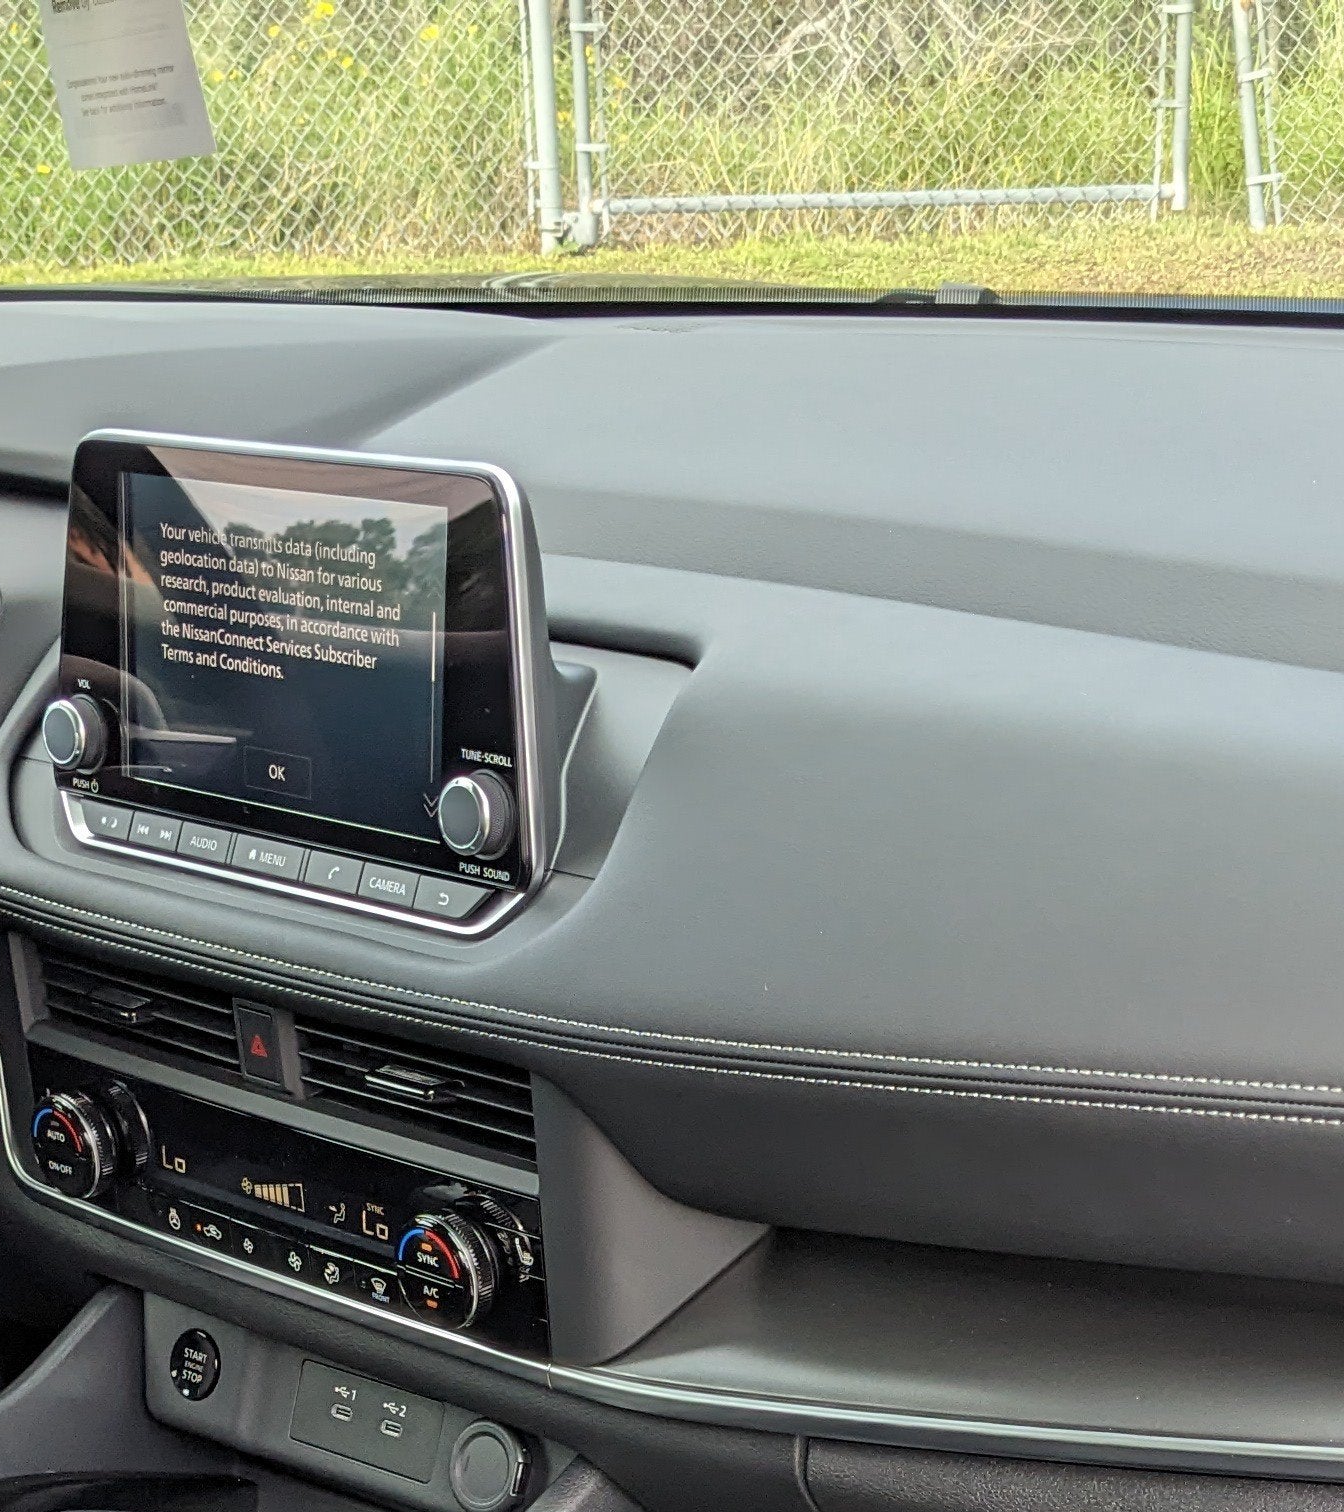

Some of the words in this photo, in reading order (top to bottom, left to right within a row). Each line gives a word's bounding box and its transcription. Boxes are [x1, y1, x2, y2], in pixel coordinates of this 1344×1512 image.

[160, 523, 186, 540] Your
[188, 527, 227, 545] vehicle
[230, 533, 282, 553] transmits
[286, 538, 311, 556] data
[315, 541, 376, 569] (including
[160, 549, 227, 571] geolocation
[229, 557, 258, 577] data)
[261, 563, 274, 577] to
[277, 563, 314, 582] Nissan
[317, 567, 336, 585] for
[338, 572, 382, 592] various
[160, 574, 209, 596] research,
[212, 581, 256, 600] product
[259, 587, 323, 612] evaluation,
[326, 595, 373, 617] internal
[377, 604, 400, 621] and
[163, 600, 228, 620] commercial
[230, 609, 284, 631] purposes,
[286, 614, 298, 631] in
[301, 621, 369, 643] accordance
[371, 629, 399, 647] with
[161, 620, 180, 637] the
[182, 623, 264, 651] NissanConnect
[267, 636, 312, 658] Services
[315, 644, 377, 670] Subscriber
[161, 644, 194, 664] Terms
[196, 652, 217, 667] and
[219, 654, 284, 679] Conditions.
[268, 764, 286, 782] OK
[73, 778, 90, 789] PUSH
[190, 836, 218, 851] AUDIO
[259, 852, 286, 867] MENU
[459, 862, 480, 875] PUSH
[483, 868, 510, 882] SOUND
[370, 877, 406, 895] CAMERA
[47, 1130, 65, 1142] AUTO
[162, 1145, 186, 1174] Lo
[366, 1203, 384, 1216] SYNC
[362, 1210, 388, 1240] Lo
[417, 1252, 439, 1267] SYNC
[424, 1285, 439, 1299] A/C
[184, 1347, 208, 1364] START
[182, 1370, 202, 1383] STOP
[399, 1405, 406, 1418] 2
